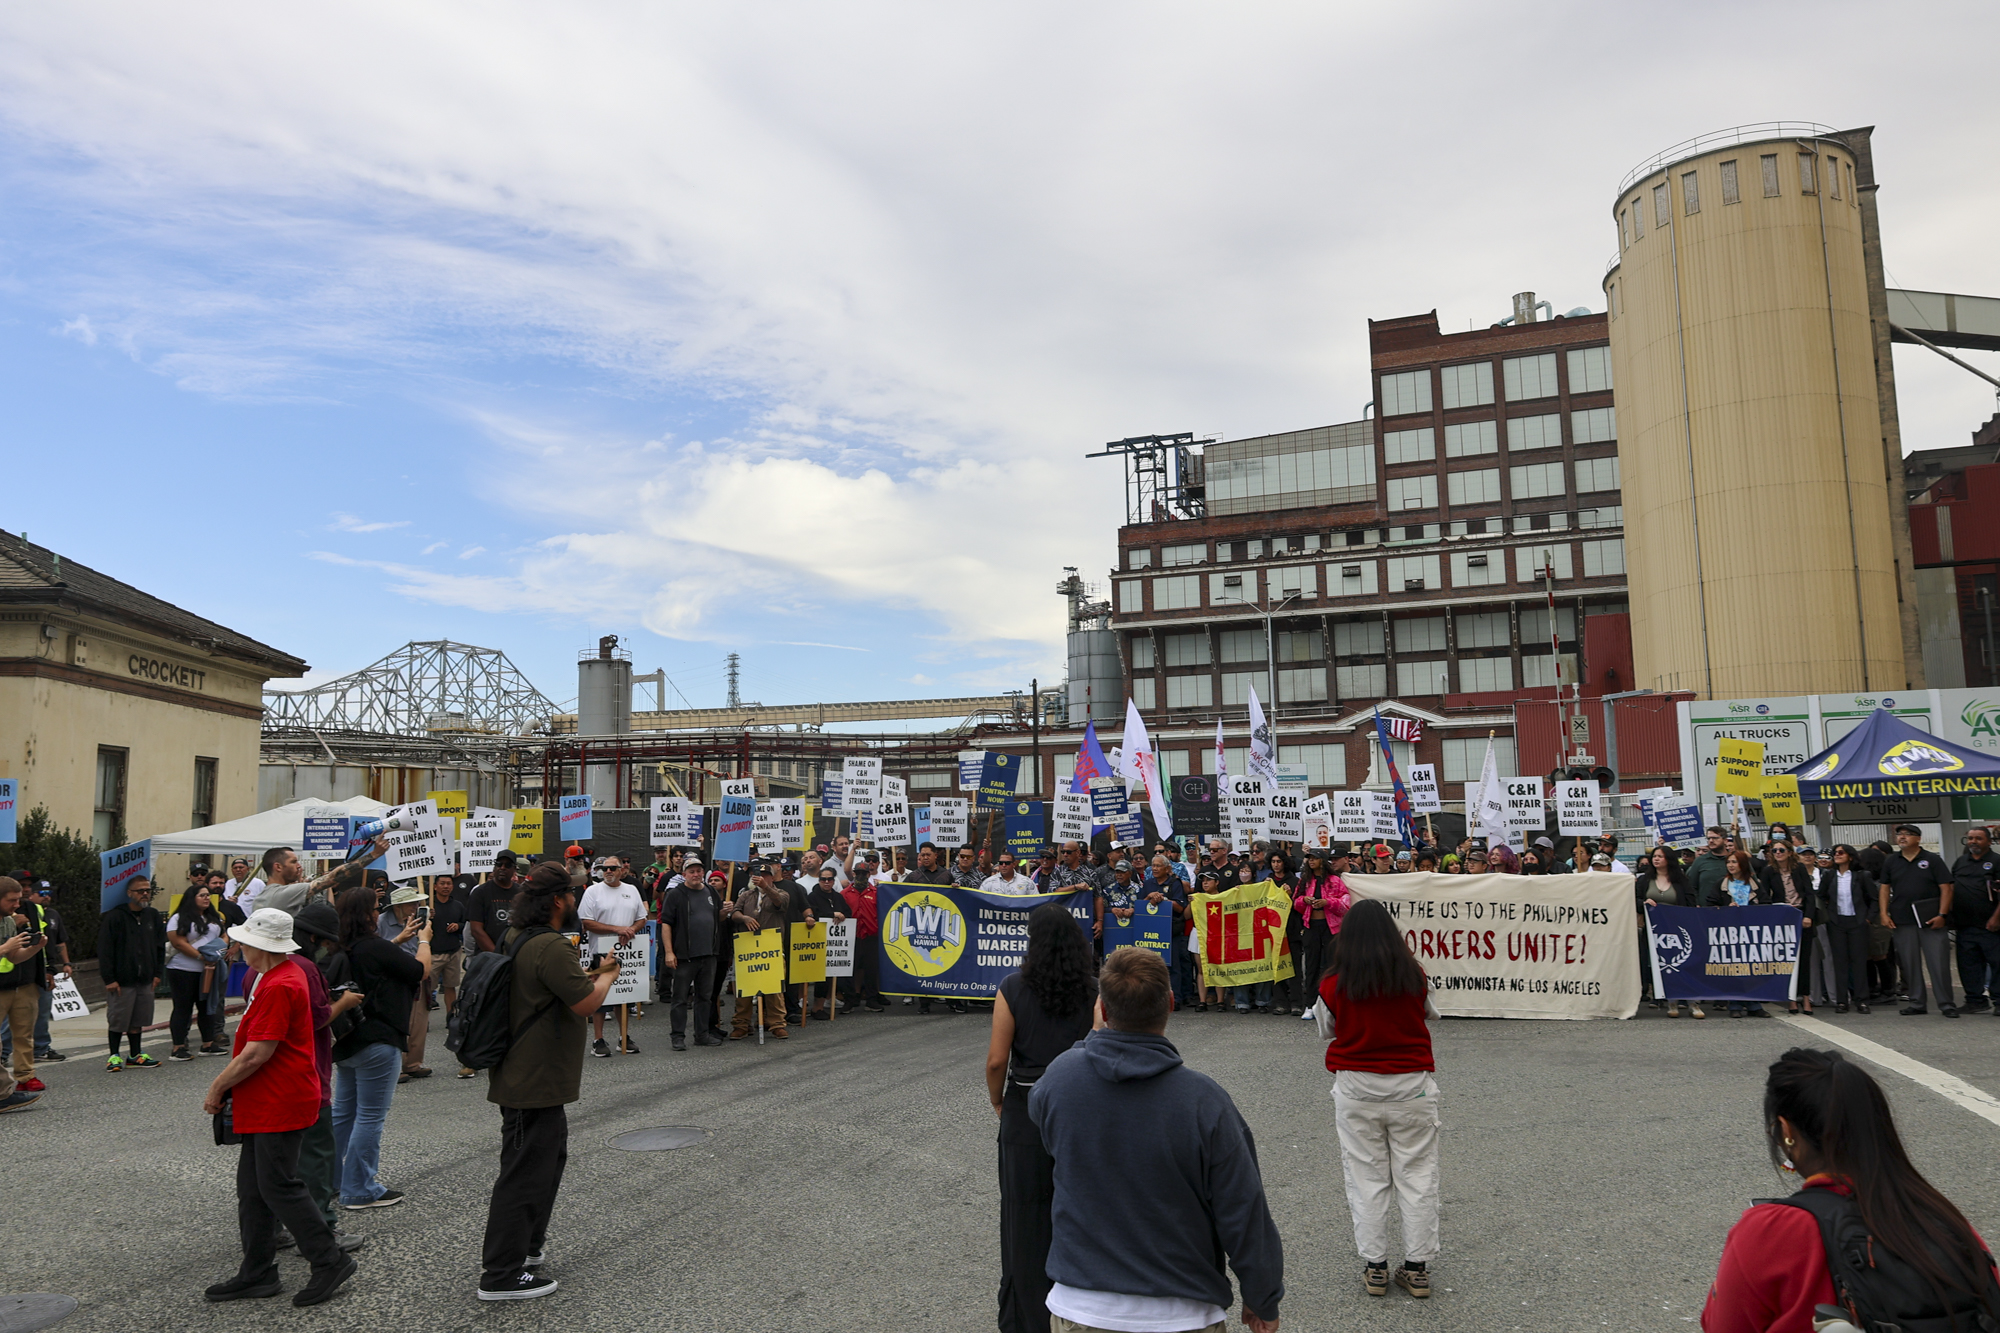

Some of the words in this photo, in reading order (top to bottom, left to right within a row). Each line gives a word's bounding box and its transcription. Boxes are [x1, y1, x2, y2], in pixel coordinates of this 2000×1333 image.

[128, 654, 205, 690] CROCKETT
[1714, 730, 1736, 740] ALL
[1739, 728, 1790, 738] TRUCKS
[1721, 757, 1760, 768] SUPPORT
[1882, 747, 1958, 773] ILWU
[1412, 771, 1430, 781] C&H
[1728, 768, 1749, 777] ILWU
[727, 784, 749, 794] C&H
[889, 781, 899, 790] C&H
[1235, 782, 1261, 794] C&H
[1412, 784, 1435, 792] UNFAIR
[1508, 784, 1536, 795] C&H
[1820, 782, 1873, 799] ILWU
[980, 787, 1014, 796] CONTRACT
[1568, 787, 1588, 798] C&H
[564, 798, 587, 808] LABOR
[1061, 795, 1079, 803] SHAME
[1233, 798, 1266, 806] UNFAIR
[1272, 796, 1297, 808] C&H
[1344, 797, 1361, 807] C&H
[416, 805, 428, 815] ON
[661, 803, 678, 812] C&H
[726, 802, 751, 816] LABOR
[878, 802, 902, 815] C&H
[1305, 800, 1325, 814] C&H
[1868, 805, 1908, 815] TURN
[561, 809, 590, 823] SOLIDARITY
[1068, 814, 1090, 822] UNFAIRLY
[1268, 810, 1300, 820] UNFAIR
[1660, 814, 1695, 823] INTERNATIONAL
[720, 820, 752, 834] SOLIDARITY
[875, 816, 907, 827] UNFAIR
[1660, 821, 1687, 830] LONGSHORE
[403, 829, 438, 843] UNFAIRLY
[1060, 831, 1084, 839] STRIKERS
[1270, 828, 1298, 836] WORKERS
[878, 834, 906, 842] WORKERS
[399, 844, 426, 858] FIRING
[109, 846, 145, 869] LABOR
[399, 856, 435, 872] STRIKERS
[104, 858, 148, 888] SOLIDARITY
[1409, 901, 1435, 918] THE
[1441, 902, 1458, 919] US
[1465, 903, 1484, 918] TO
[1489, 902, 1516, 920] THE
[1523, 904, 1608, 924] PHILIPPINES
[829, 926, 846, 937] C&H
[889, 905, 961, 947] ILWU
[978, 924, 1027, 936] LONGS
[1144, 932, 1159, 940] FAIR
[1708, 925, 1796, 945] KABATAAN
[793, 942, 825, 951] SUPPORT
[914, 939, 939, 947] HAWAII
[978, 939, 1027, 951] WAREH
[1135, 940, 1170, 949] CONTRACT
[1405, 929, 1496, 960] ORKERS
[1507, 932, 1587, 964] UNITE!
[738, 950, 780, 962] SUPPORT
[799, 954, 816, 962] ILWU
[1708, 944, 1796, 963] ALLIANCE
[977, 955, 1023, 967] UNION
[748, 963, 770, 973] ILWU
[1209, 968, 1215, 976] La
[1227, 965, 1257, 976] Internacional
[1705, 963, 1750, 976] NORTHERN
[934, 980, 958, 991] Injury
[971, 982, 986, 990] One
[988, 983, 996, 991] is
[1446, 975, 1505, 992] UNYONISTA
[1510, 978, 1524, 992] NG
[1529, 979, 1548, 993] LOS
[1553, 980, 1600, 996] ANGELES
[54, 1001, 81, 1013] C&H
